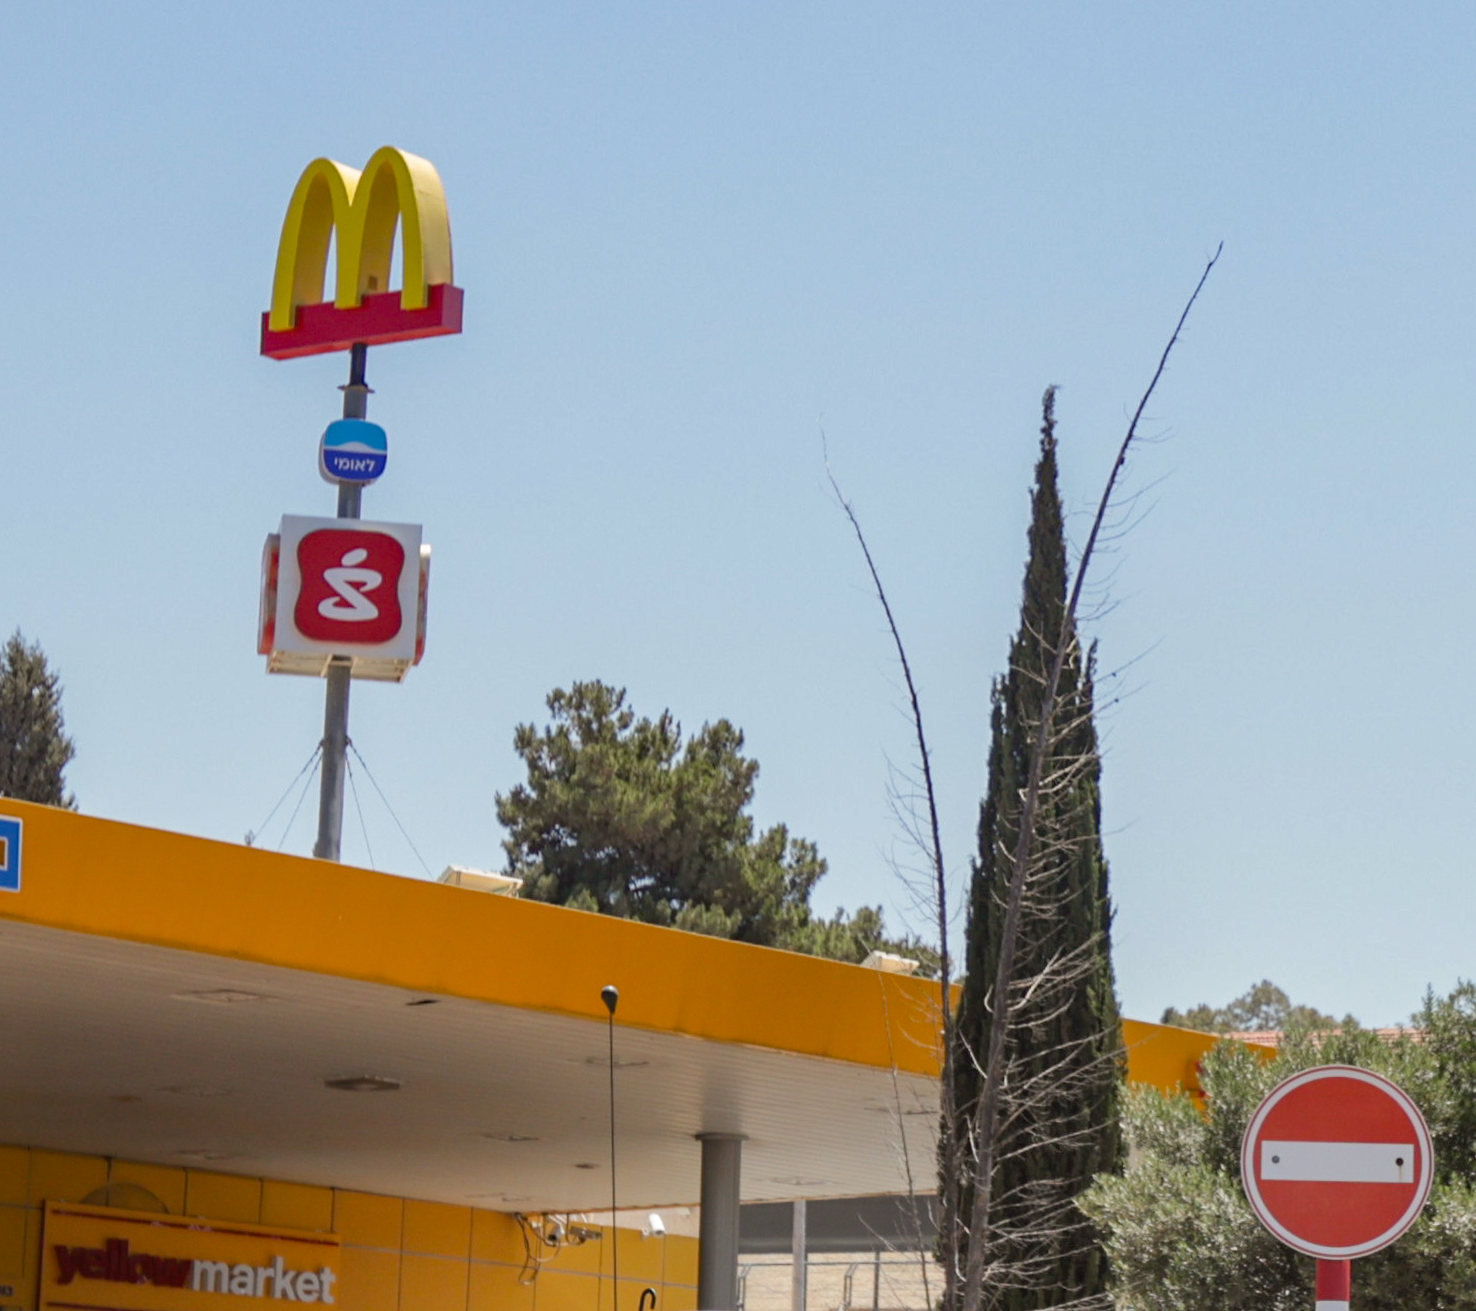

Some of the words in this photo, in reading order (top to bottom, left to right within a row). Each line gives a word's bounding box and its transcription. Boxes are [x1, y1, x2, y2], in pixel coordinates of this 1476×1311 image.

[334, 457, 376, 472] לאומי
[54, 1238, 193, 1287] yellow
[191, 1255, 339, 1305] market
